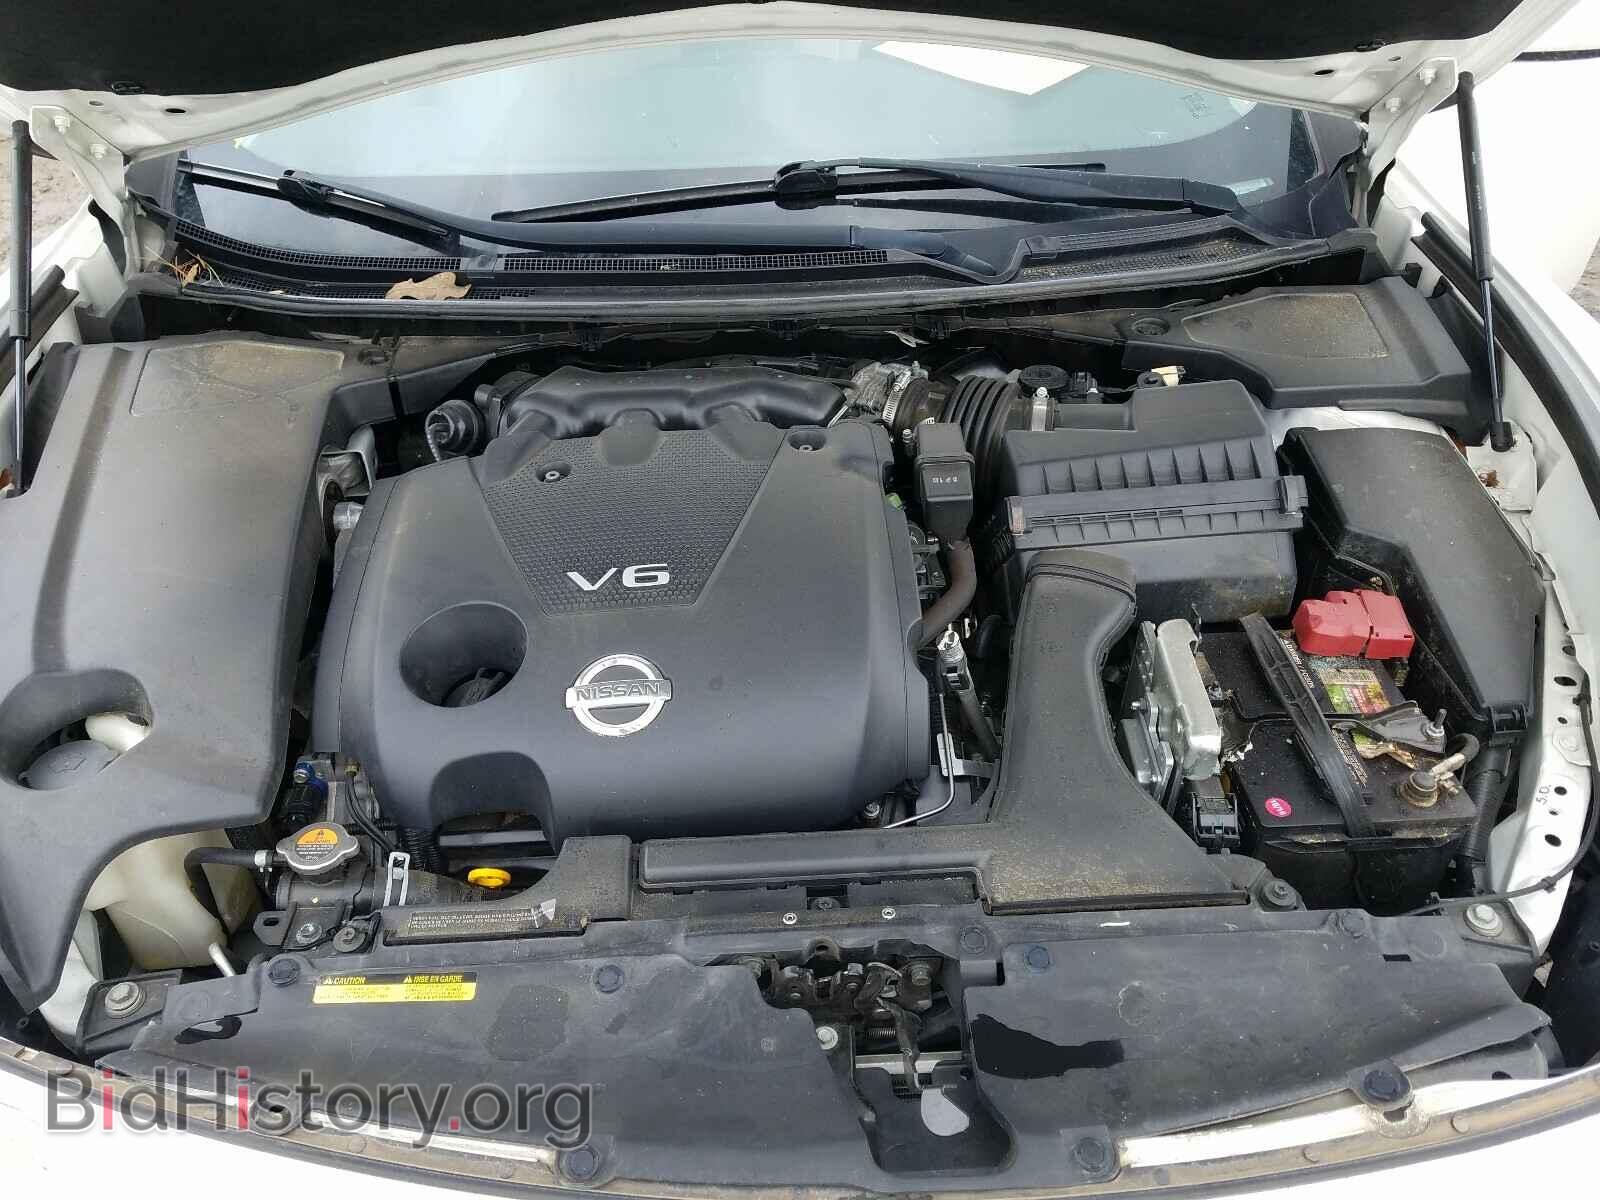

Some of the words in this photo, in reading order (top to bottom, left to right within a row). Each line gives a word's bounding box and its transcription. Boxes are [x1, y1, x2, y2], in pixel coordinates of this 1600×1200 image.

[566, 563, 671, 591] V6
[576, 682, 661, 701] NISSAN
[333, 976, 366, 985] CAUTION
[440, 975, 463, 983] GARDE
